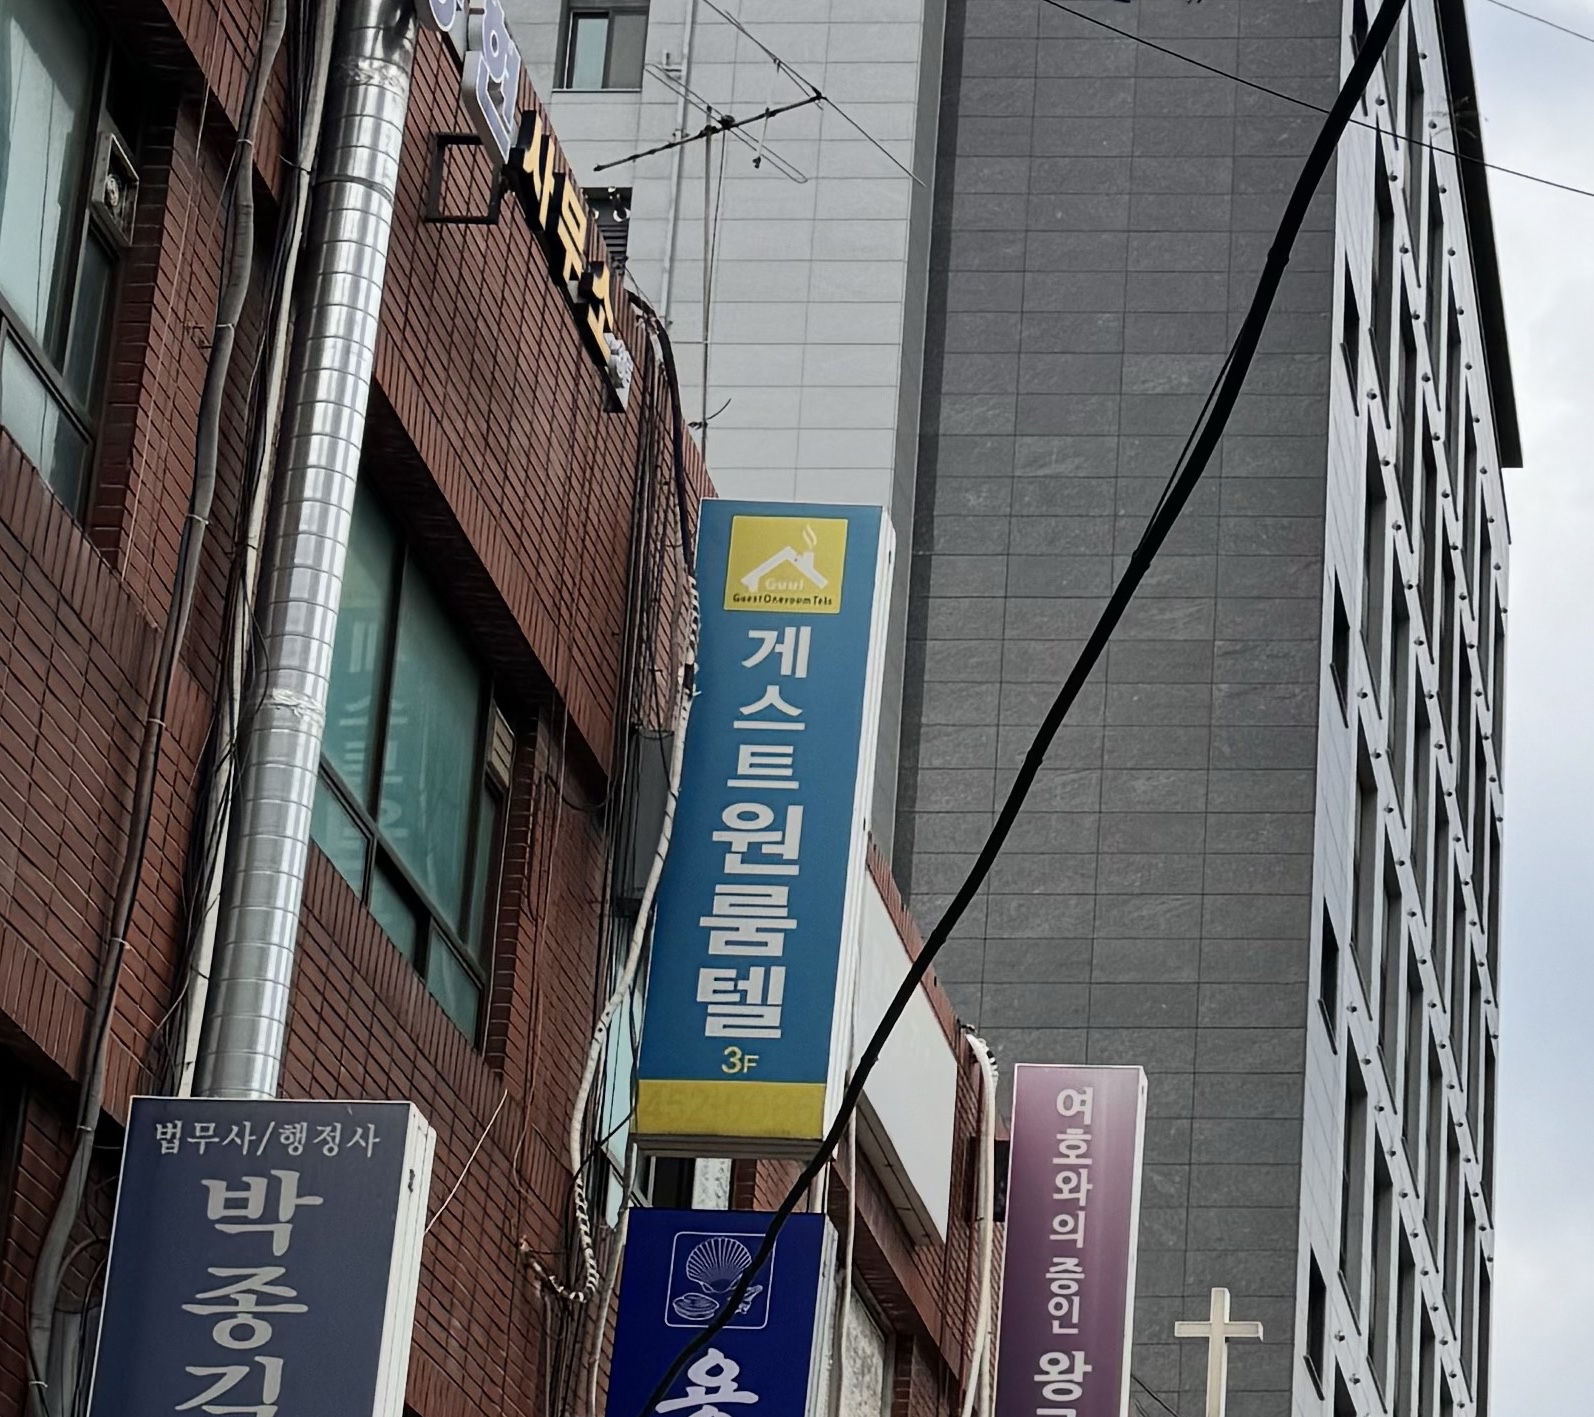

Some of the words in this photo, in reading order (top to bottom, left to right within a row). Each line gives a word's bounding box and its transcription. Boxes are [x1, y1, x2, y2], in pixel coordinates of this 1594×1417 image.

[696, 626, 811, 1039] 게스트원룸텔
[721, 1046, 759, 1074] 3F
[155, 1120, 380, 1158] 법무사/행정사
[1049, 1086, 1094, 1249] 여호와의
[1047, 1257, 1085, 1335] 증인
